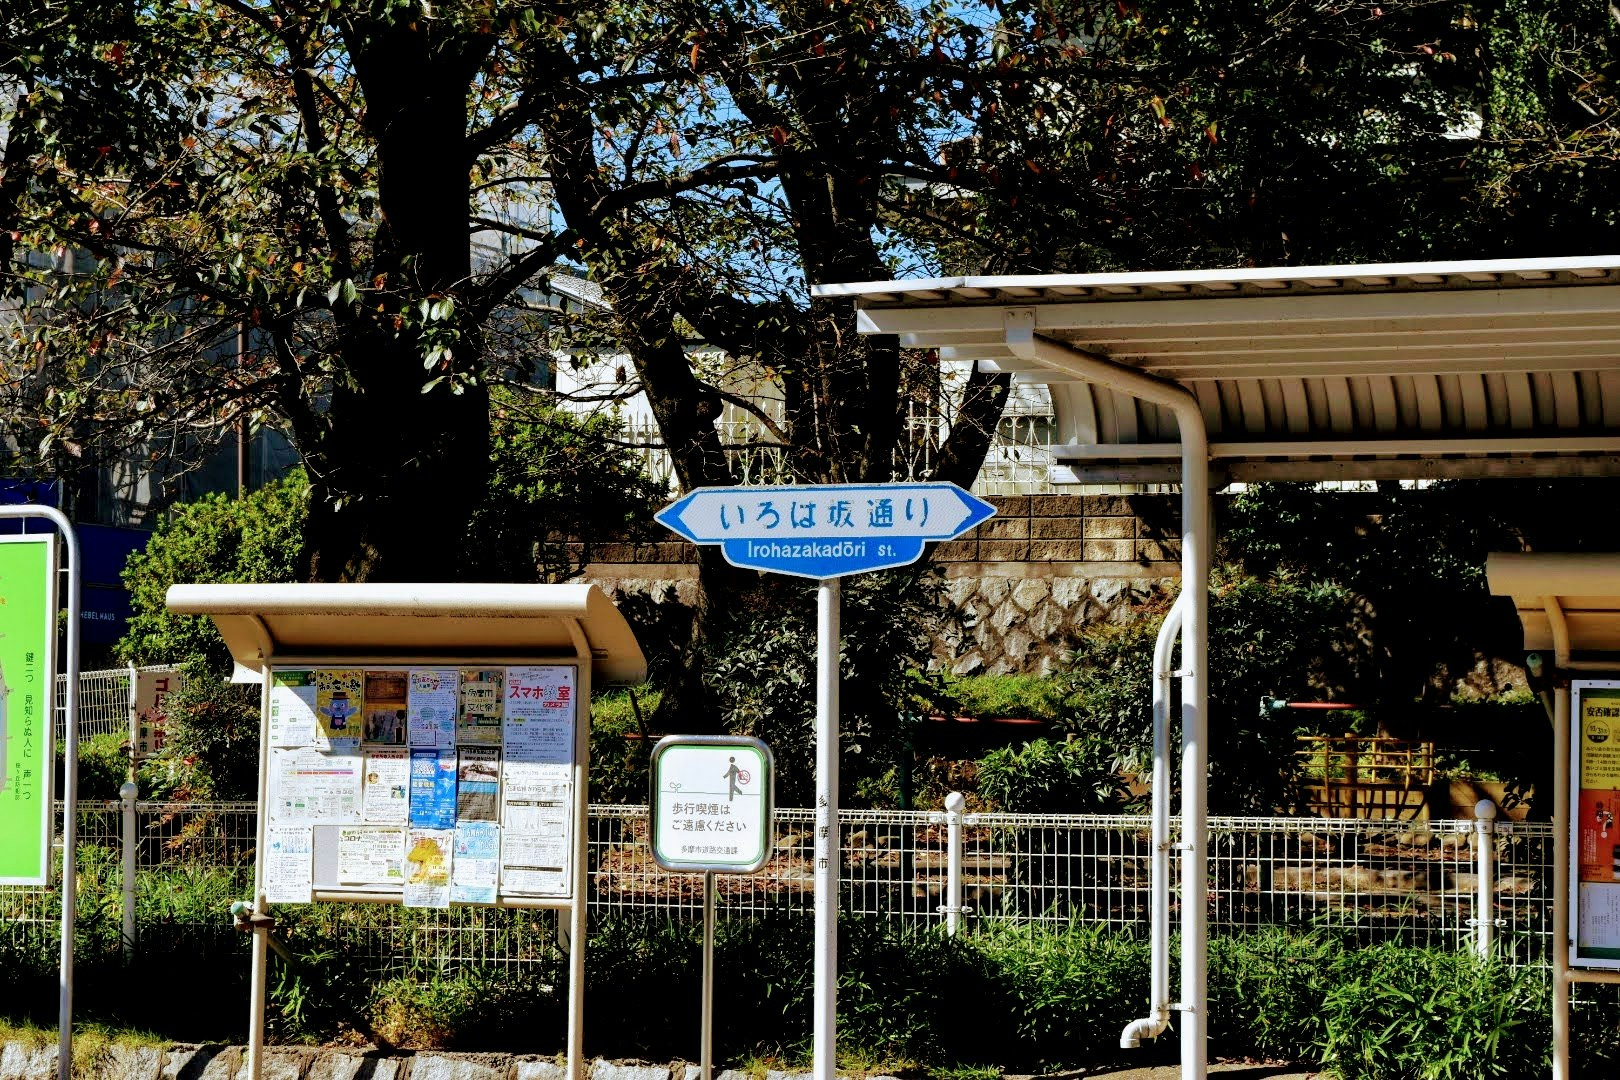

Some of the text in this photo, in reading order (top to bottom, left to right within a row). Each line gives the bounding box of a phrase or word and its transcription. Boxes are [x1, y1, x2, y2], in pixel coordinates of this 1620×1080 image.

[720, 498, 929, 530] いろは坂通り
[748, 541, 865, 558] Irohazakadōri
[22, 652, 34, 800] 鍵二つ 見知らぬ人に 声一つ
[672, 802, 731, 816] 歩行喫煙は
[672, 819, 747, 832] ご遠慮ください
[818, 794, 830, 870] 多摩市
